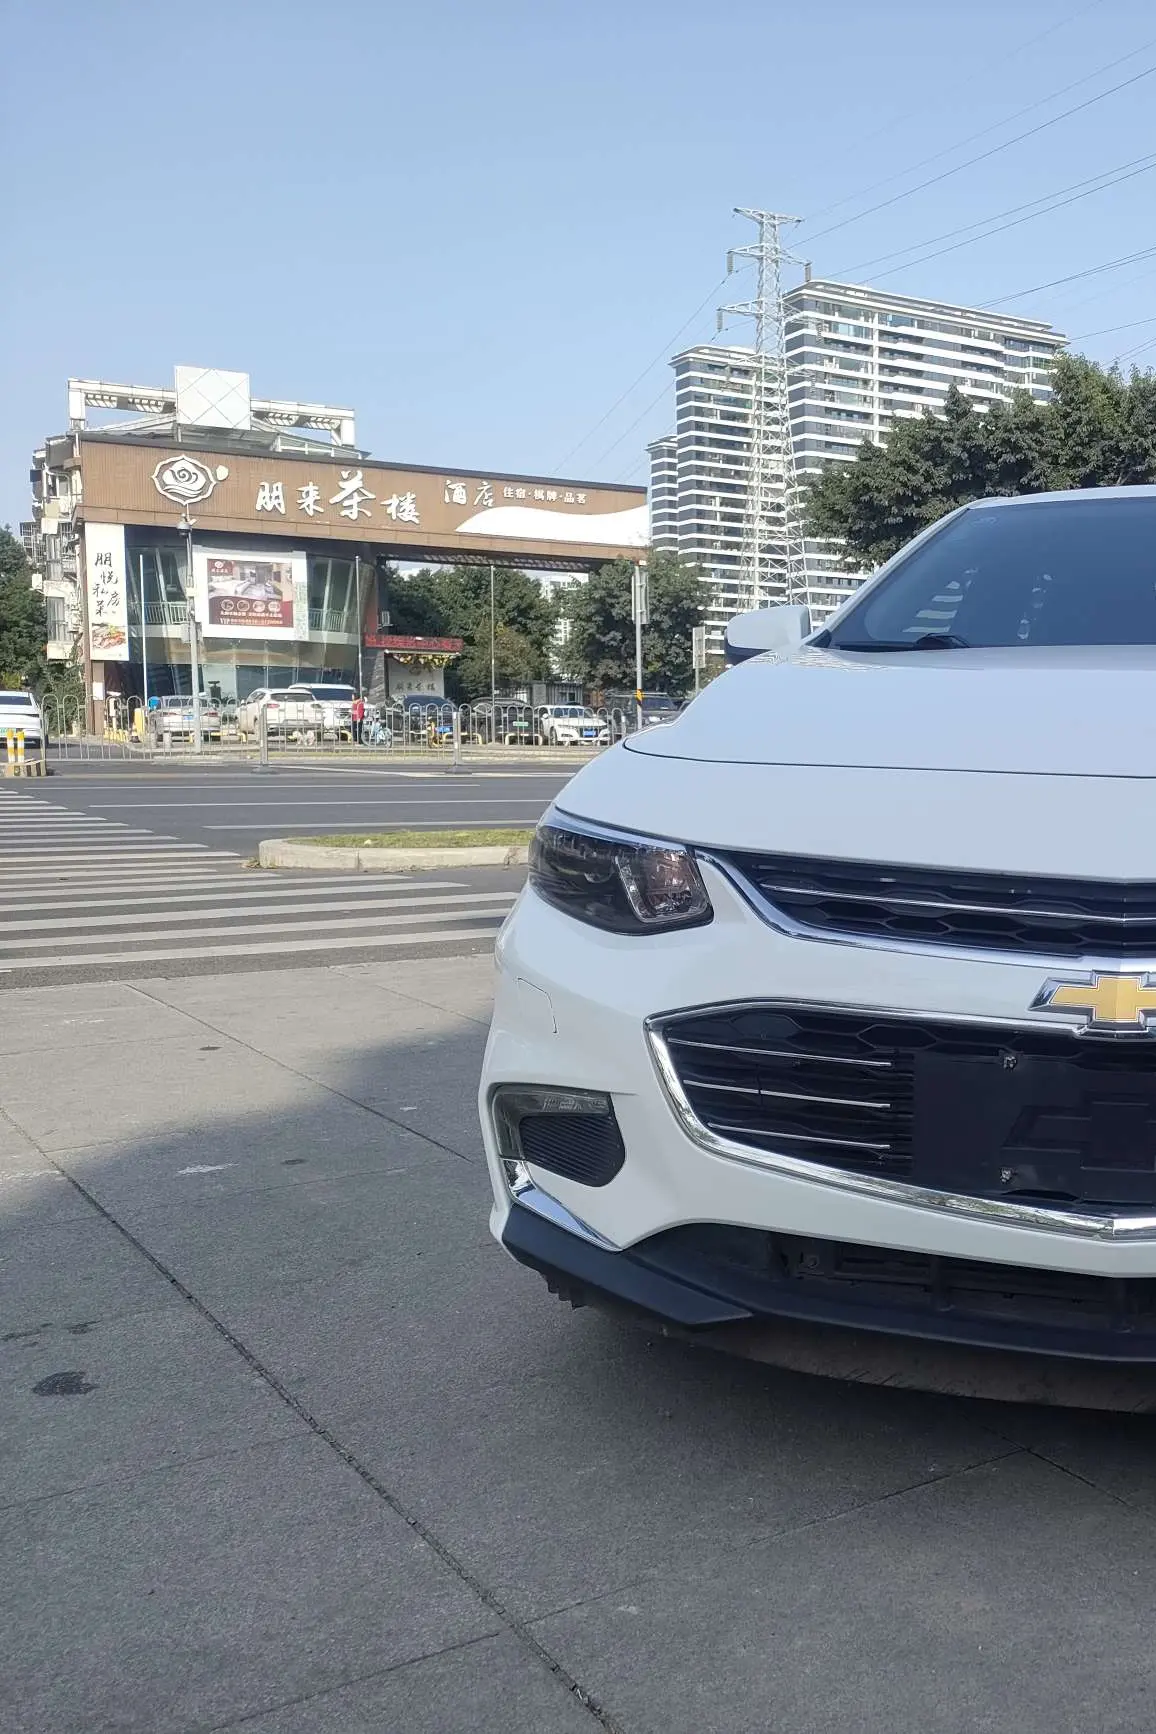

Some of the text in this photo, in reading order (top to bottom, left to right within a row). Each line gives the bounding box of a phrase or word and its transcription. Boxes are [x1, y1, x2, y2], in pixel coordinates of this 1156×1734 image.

[255, 470, 421, 525] 朋来茶楼
[444, 479, 494, 507] 酒店
